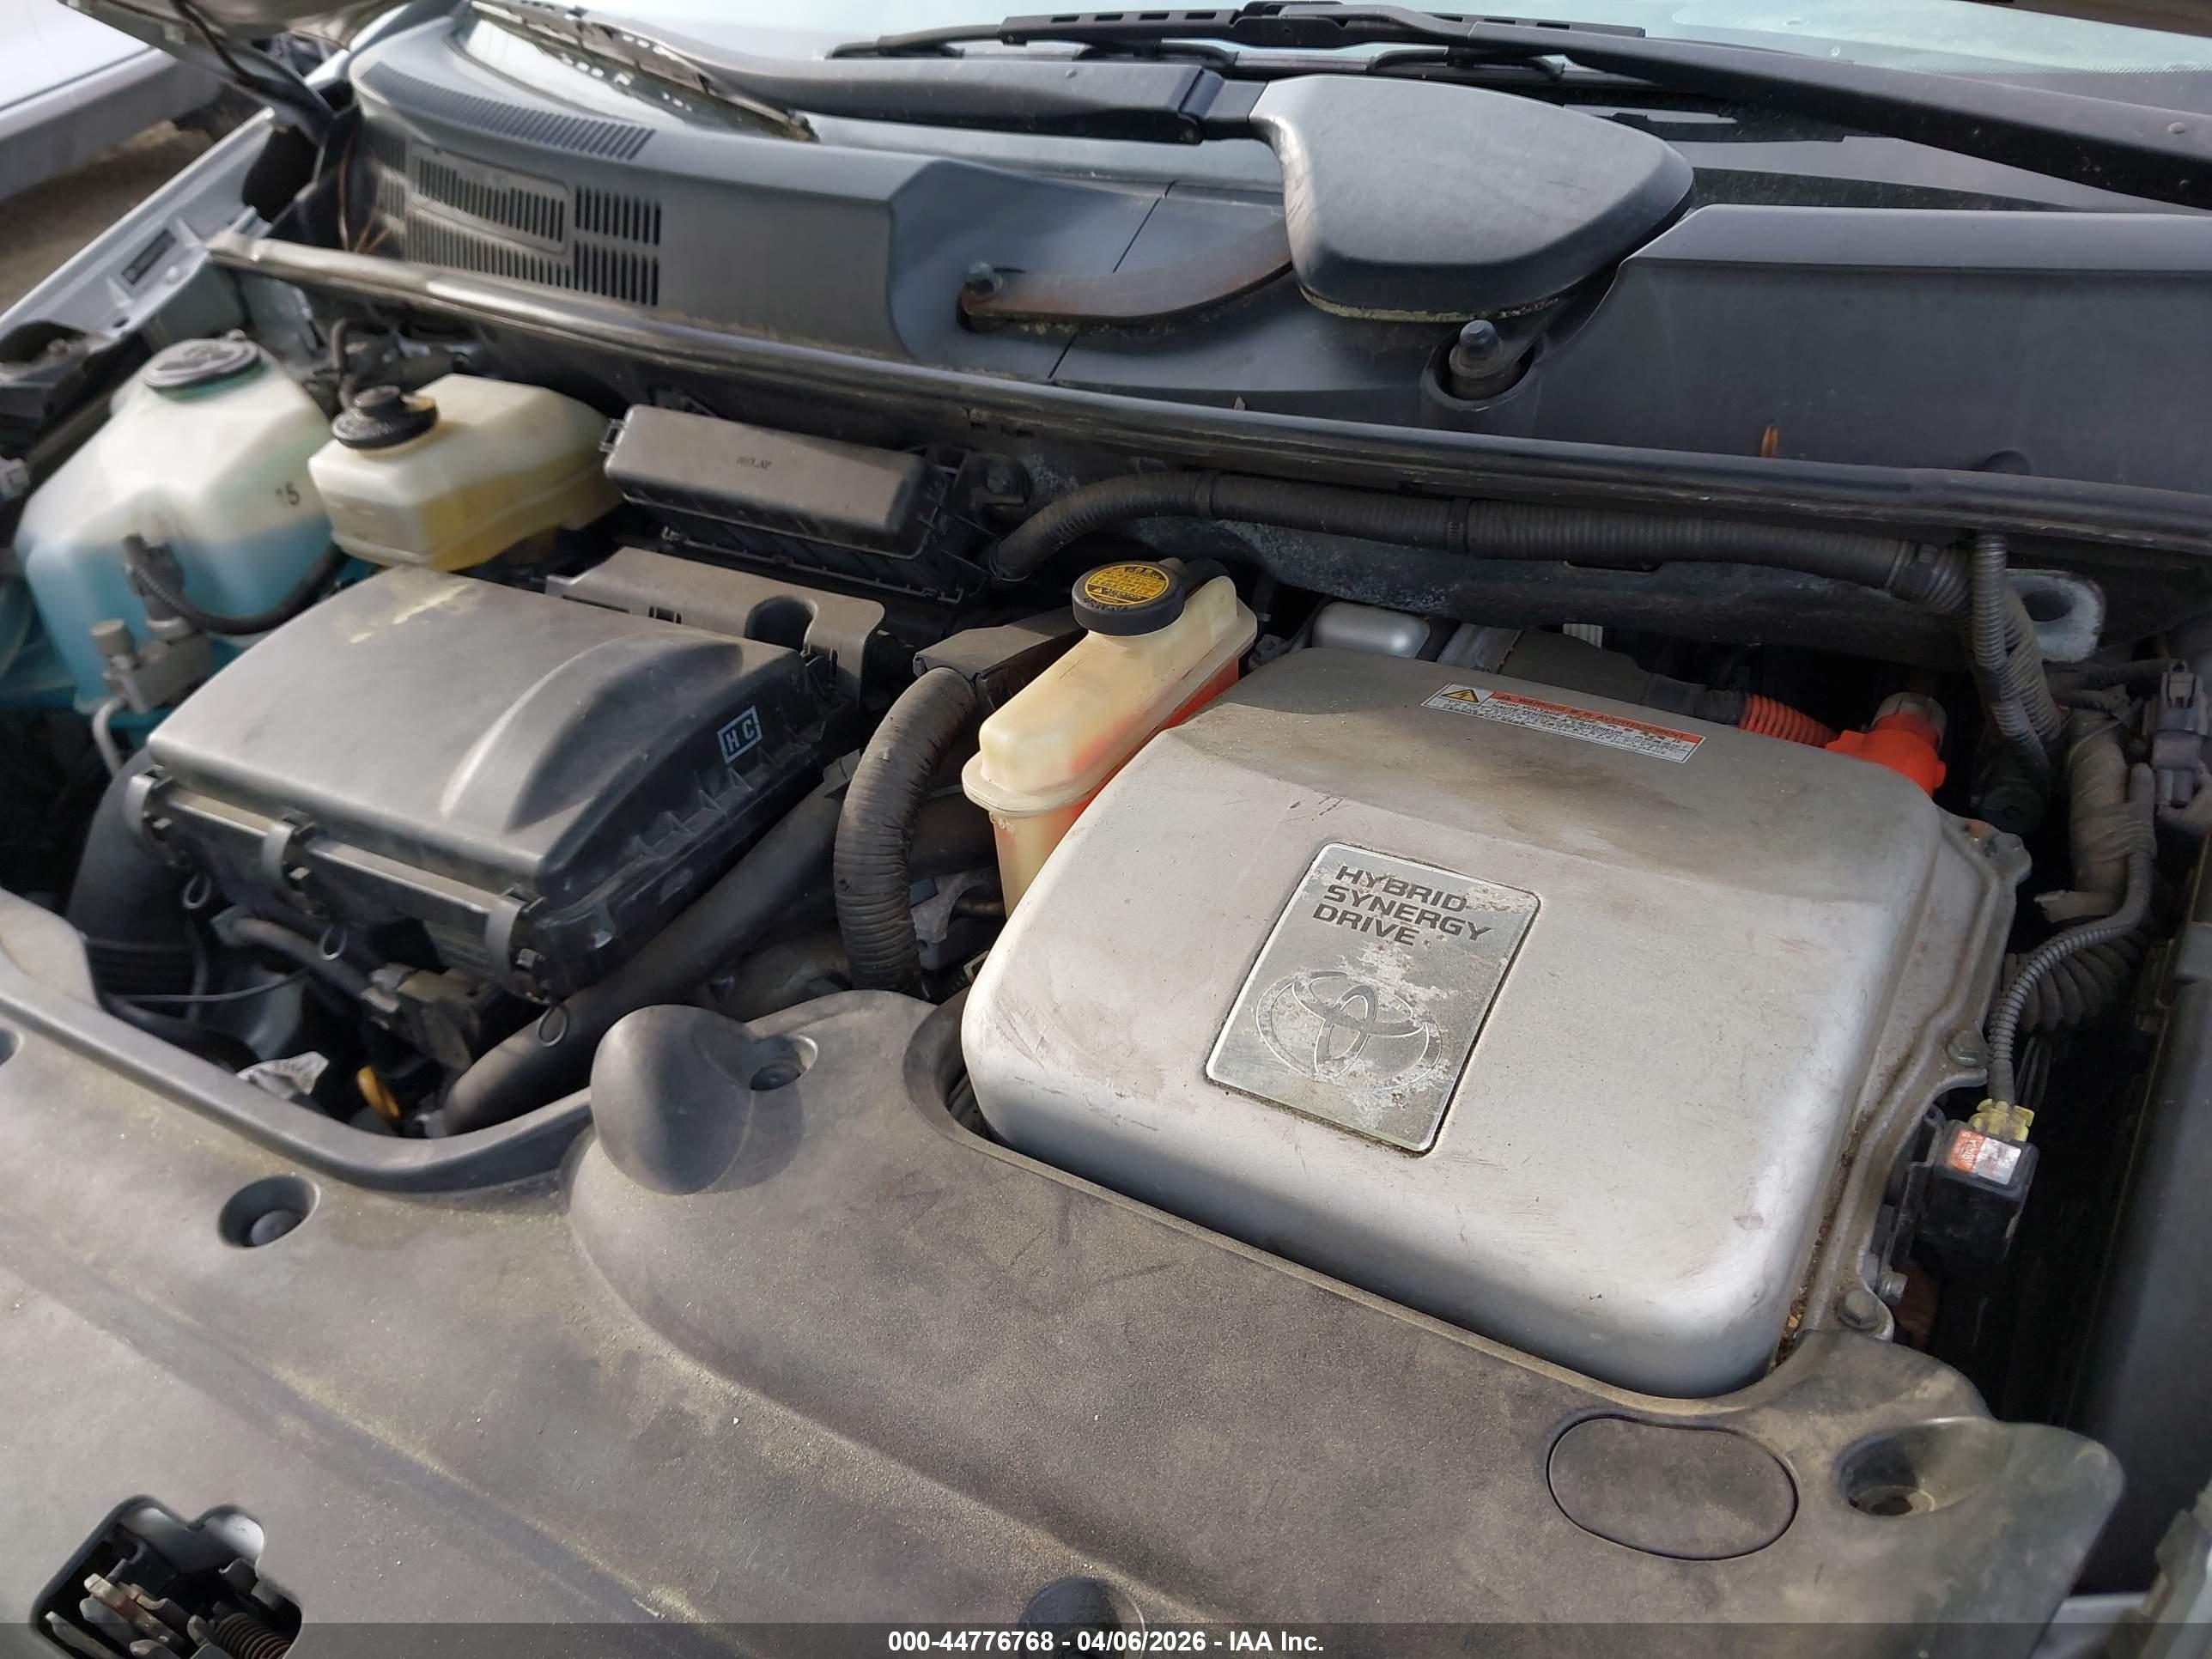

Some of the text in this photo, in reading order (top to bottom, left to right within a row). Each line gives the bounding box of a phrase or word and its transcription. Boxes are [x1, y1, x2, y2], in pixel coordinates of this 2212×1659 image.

[1335, 866, 1468, 912] HYBRID
[1312, 902, 1419, 946] DRIVE
[1323, 884, 1492, 941] SYNERGY
